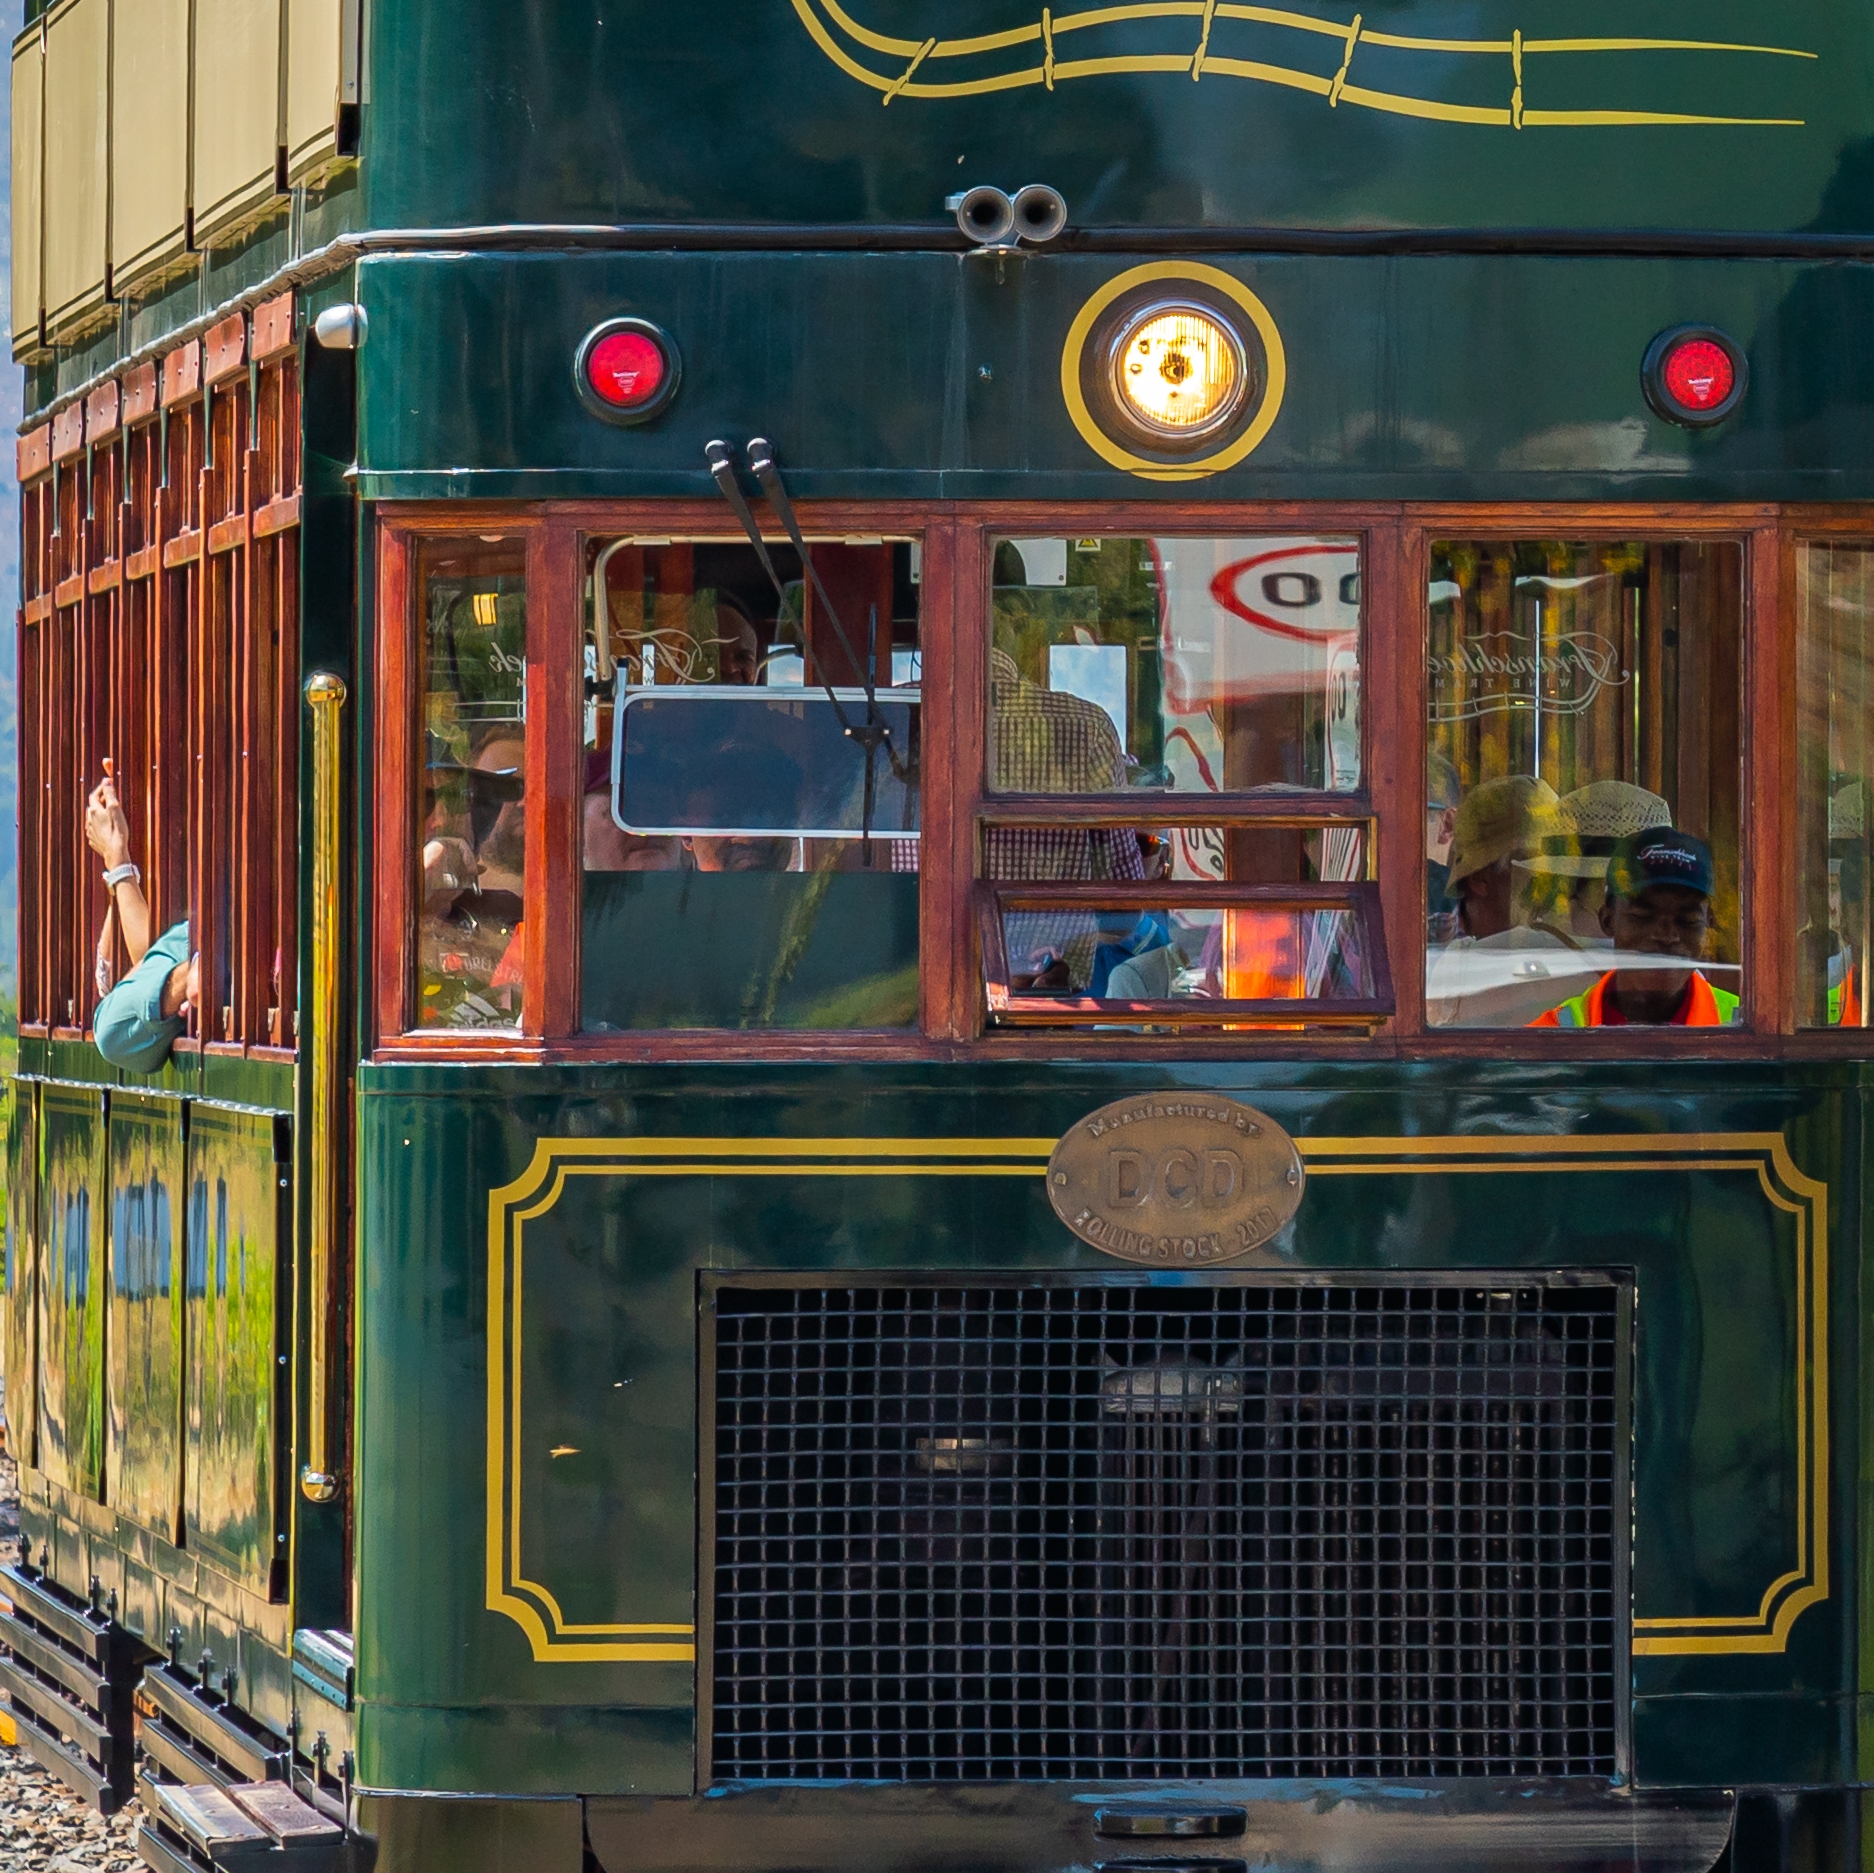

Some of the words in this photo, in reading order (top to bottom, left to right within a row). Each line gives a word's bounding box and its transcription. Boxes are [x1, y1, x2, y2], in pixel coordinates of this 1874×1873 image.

[1087, 1102, 1230, 1138] Manufactured
[1235, 1111, 1261, 1138] by
[1108, 1146, 1243, 1209] DCD
[1074, 1207, 1152, 1257] ROLLING
[1157, 1231, 1224, 1259] STOCK
[1236, 1206, 1280, 1247] 2017
